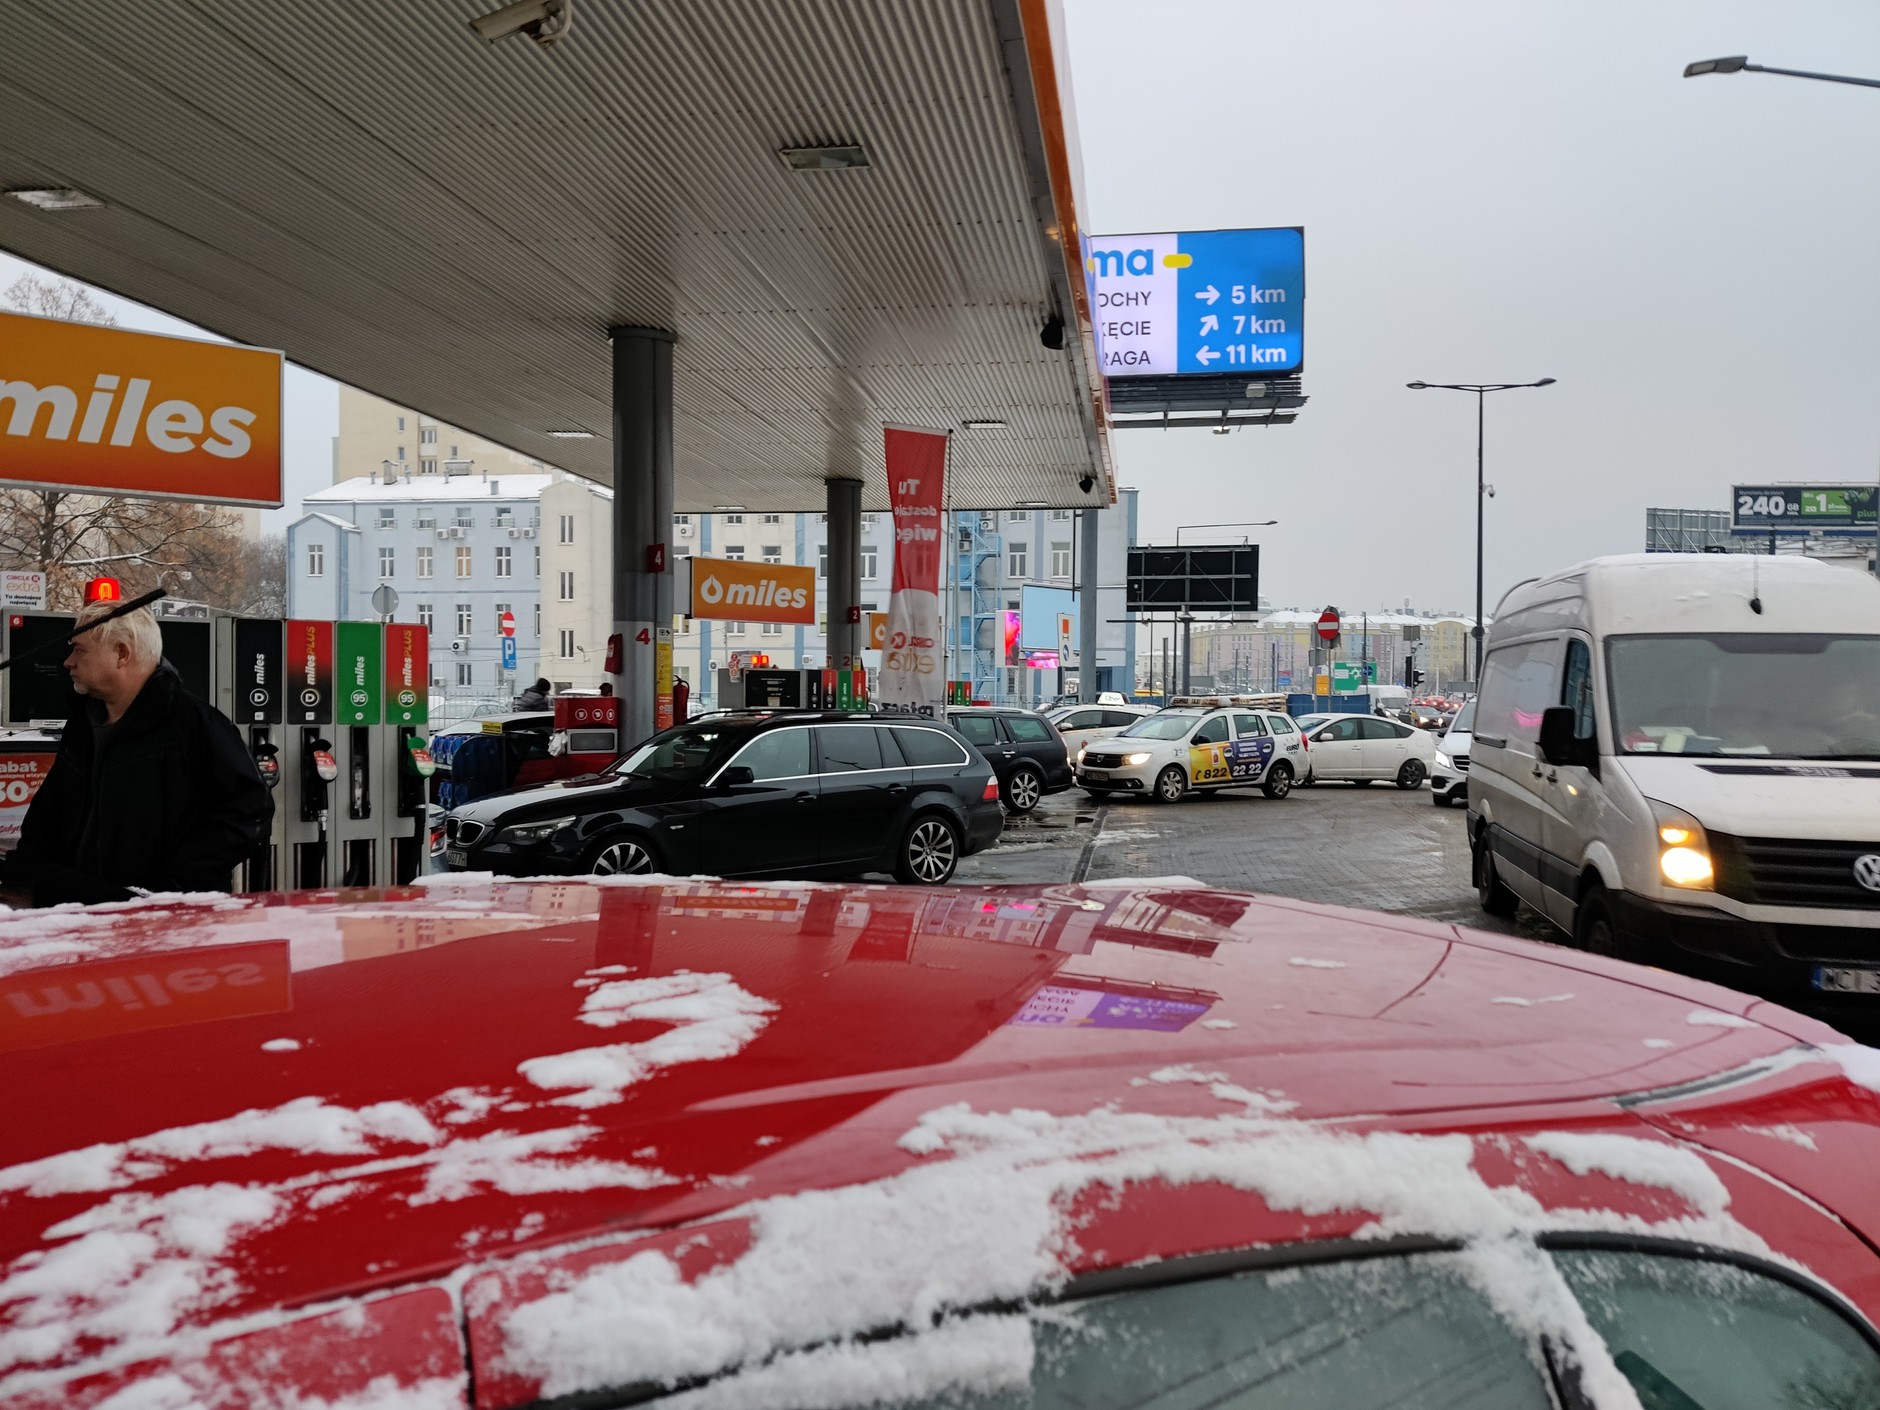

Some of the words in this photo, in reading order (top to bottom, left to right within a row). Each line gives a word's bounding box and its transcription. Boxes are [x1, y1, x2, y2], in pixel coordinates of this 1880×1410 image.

[1231, 285, 1245, 304] 5
[1251, 285, 1286, 304] km
[1232, 316, 1246, 334] 7
[1251, 315, 1286, 334] km
[1226, 344, 1246, 364] 11
[1252, 344, 1287, 363] km
[0, 373, 257, 459] miles
[1738, 495, 1786, 516] 240
[1816, 493, 1827, 513] 1
[654, 551, 661, 565] 4
[6, 581, 40, 592] extra
[726, 579, 808, 609] miles
[635, 627, 651, 645] 4
[254, 653, 265, 685] miles
[354, 656, 365, 686] miles
[353, 693, 366, 703] 95
[400, 693, 414, 703] 95
[1203, 768, 1228, 779] 822
[1232, 765, 1246, 776] 22
[1248, 763, 1262, 774] 22
